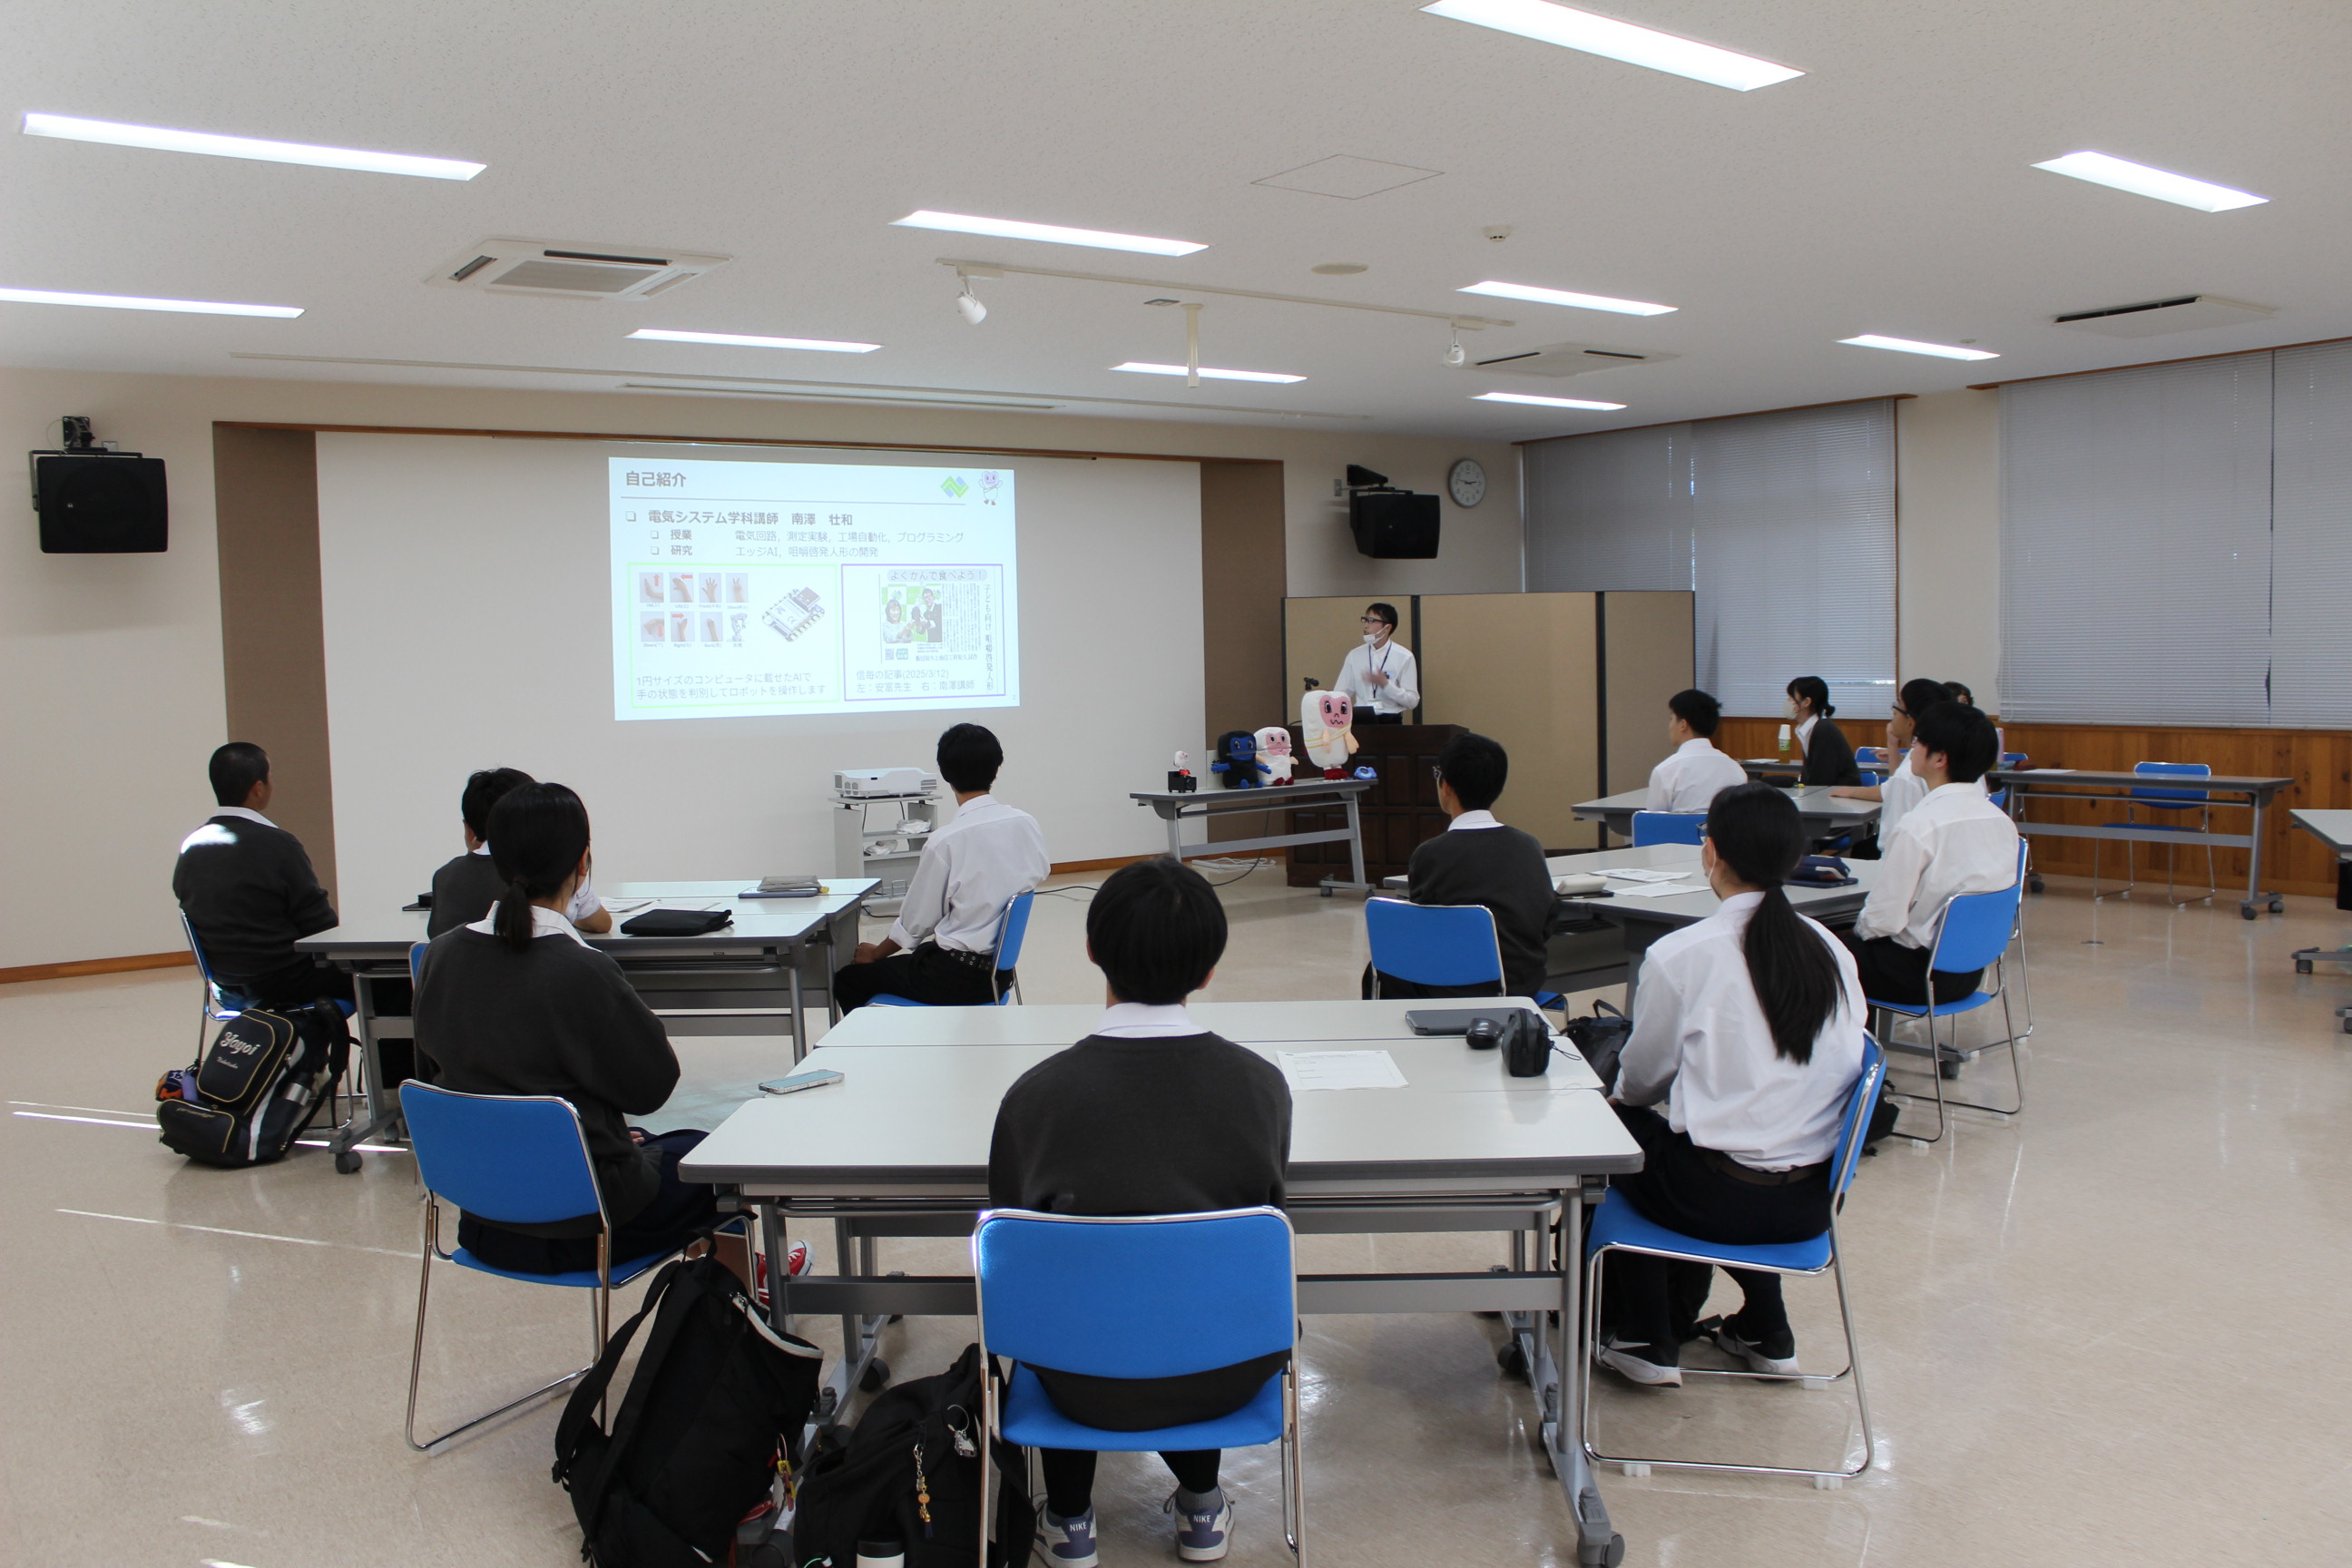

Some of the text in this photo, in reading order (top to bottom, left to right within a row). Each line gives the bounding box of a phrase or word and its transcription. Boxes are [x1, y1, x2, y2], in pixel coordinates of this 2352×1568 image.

[626, 470, 687, 487] 自己紹介
[648, 509, 779, 524] 電気システム学科講師
[791, 513, 816, 525] 南澤
[671, 529, 692, 541] 授業
[671, 545, 692, 556] 研究
[220, 1031, 261, 1055] Yayoi
[1193, 1514, 1210, 1524] NIKE
[1069, 1522, 1087, 1533] NIKE
